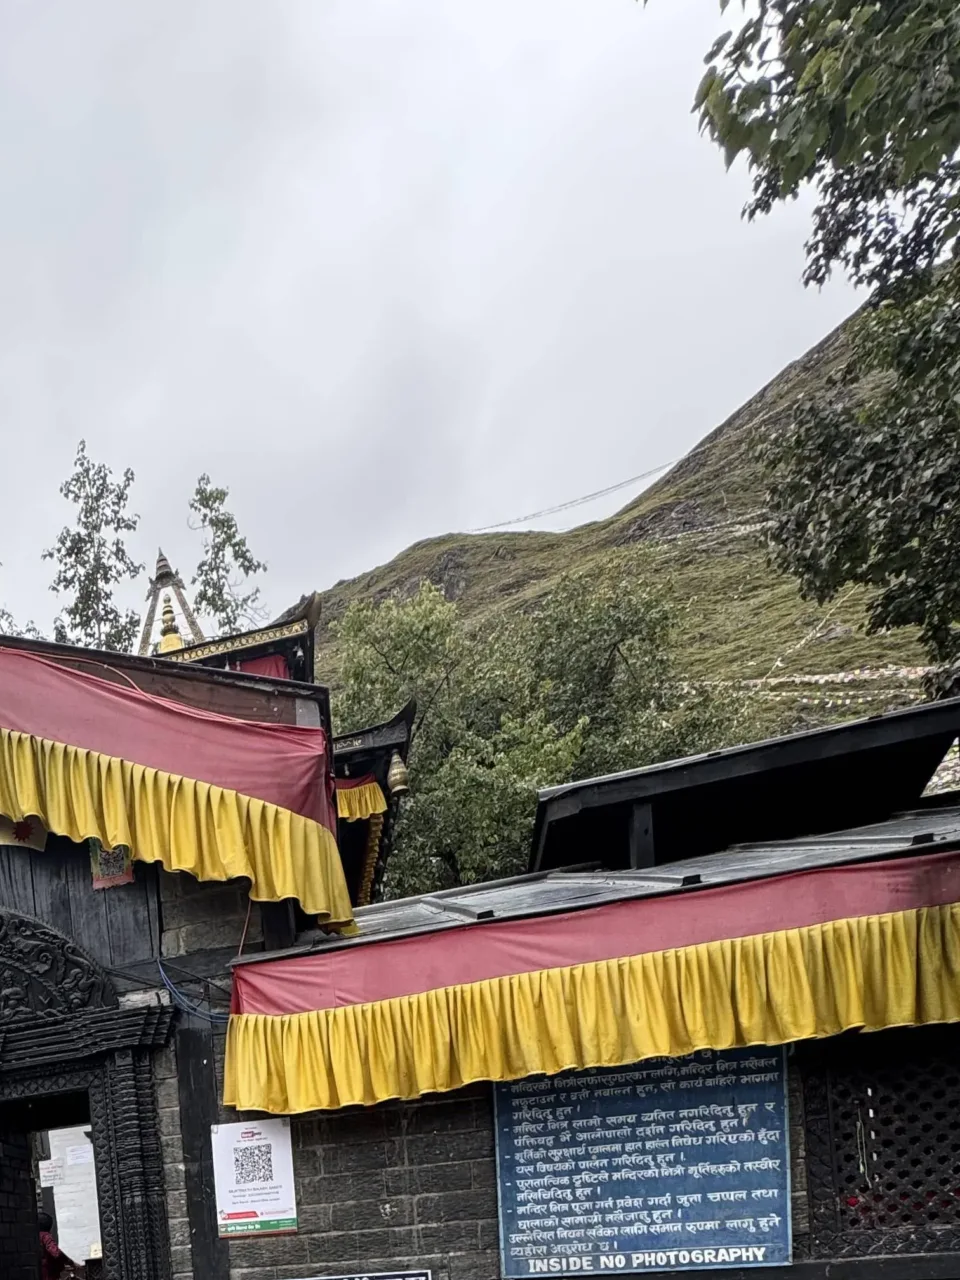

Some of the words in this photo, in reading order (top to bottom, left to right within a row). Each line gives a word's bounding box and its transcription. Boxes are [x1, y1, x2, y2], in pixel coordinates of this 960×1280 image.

[513, 1122, 544, 1133] मन्दिर
[572, 1115, 603, 1129] लामो
[606, 1114, 637, 1126] समय
[611, 1166, 658, 1180] मन्दिरको
[516, 1203, 547, 1214] मन्दिर
[750, 1189, 779, 1199] तथा
[649, 1223, 682, 1234] समान
[528, 1257, 593, 1272] INSIDE
[600, 1255, 626, 1268] NO
[631, 1248, 766, 1266] PHOTOGRAPHY
